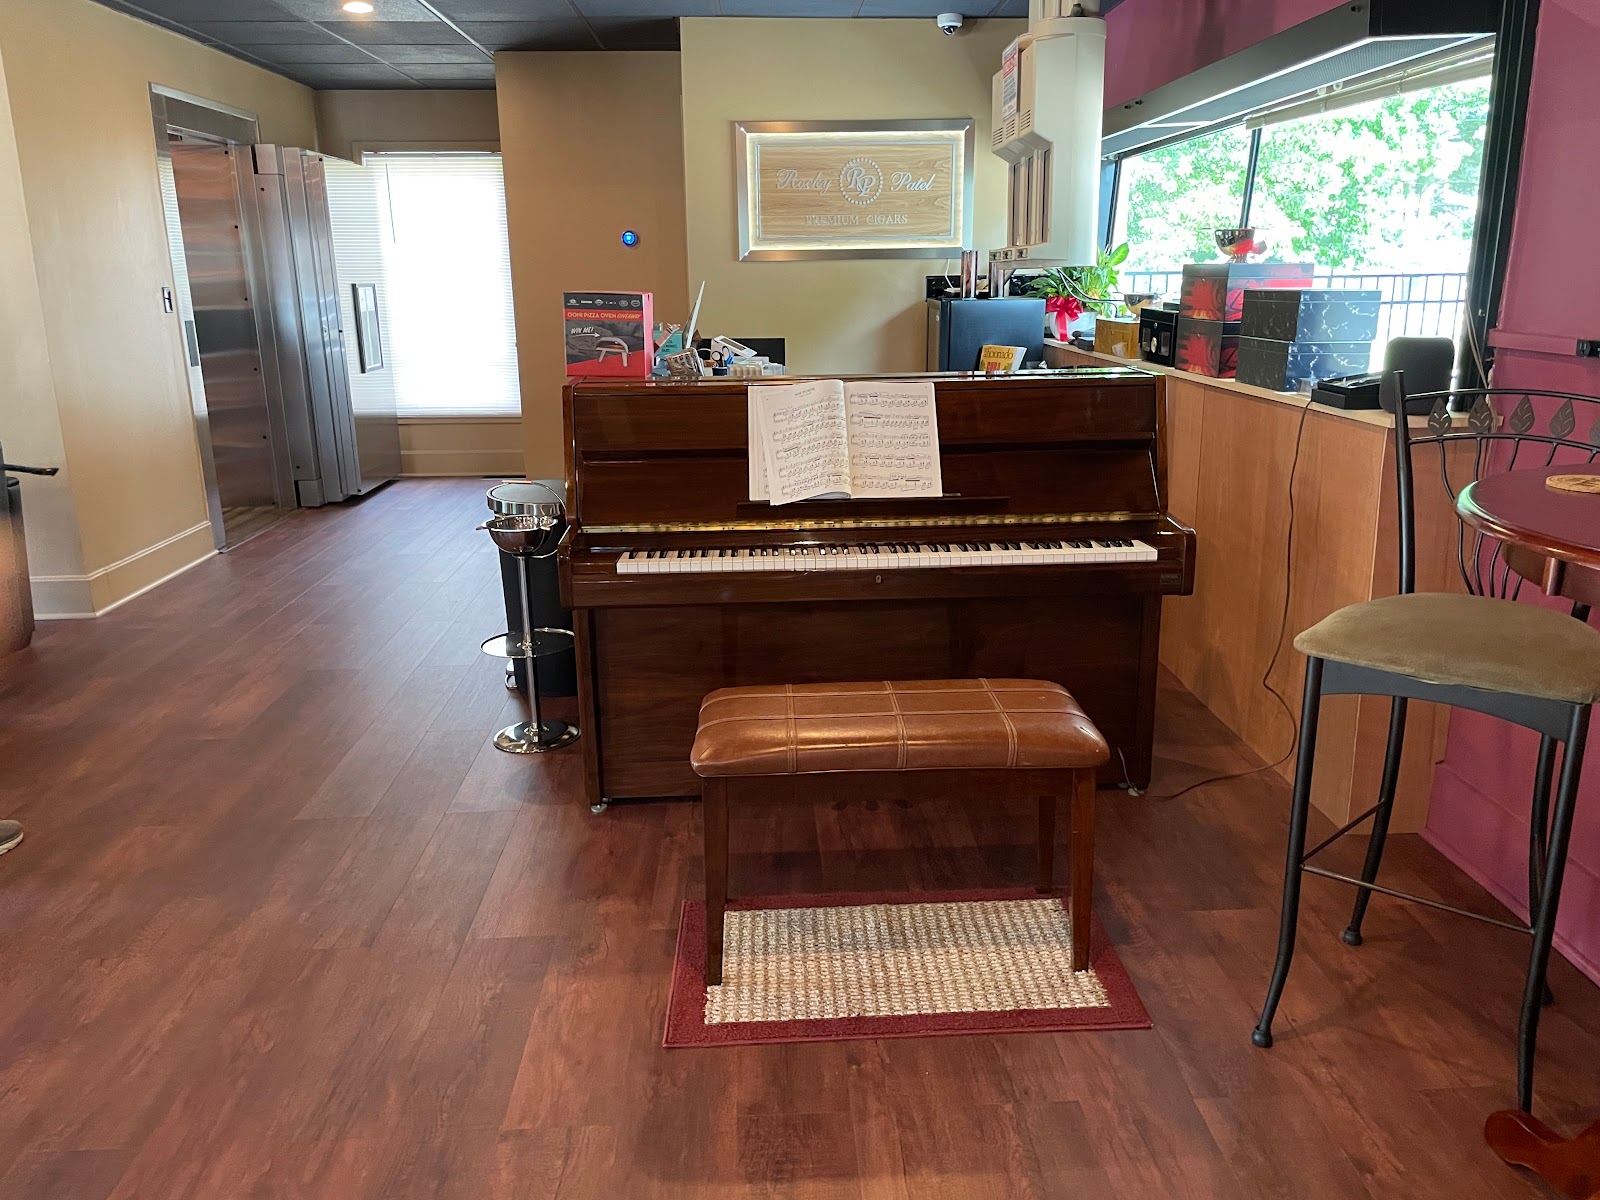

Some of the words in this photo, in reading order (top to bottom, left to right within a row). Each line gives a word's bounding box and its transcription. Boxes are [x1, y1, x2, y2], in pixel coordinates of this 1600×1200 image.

[776, 169, 832, 196] Rocky
[890, 171, 936, 192] Patel
[805, 215, 859, 226] PREMIUM
[866, 214, 908, 225] CIGARS
